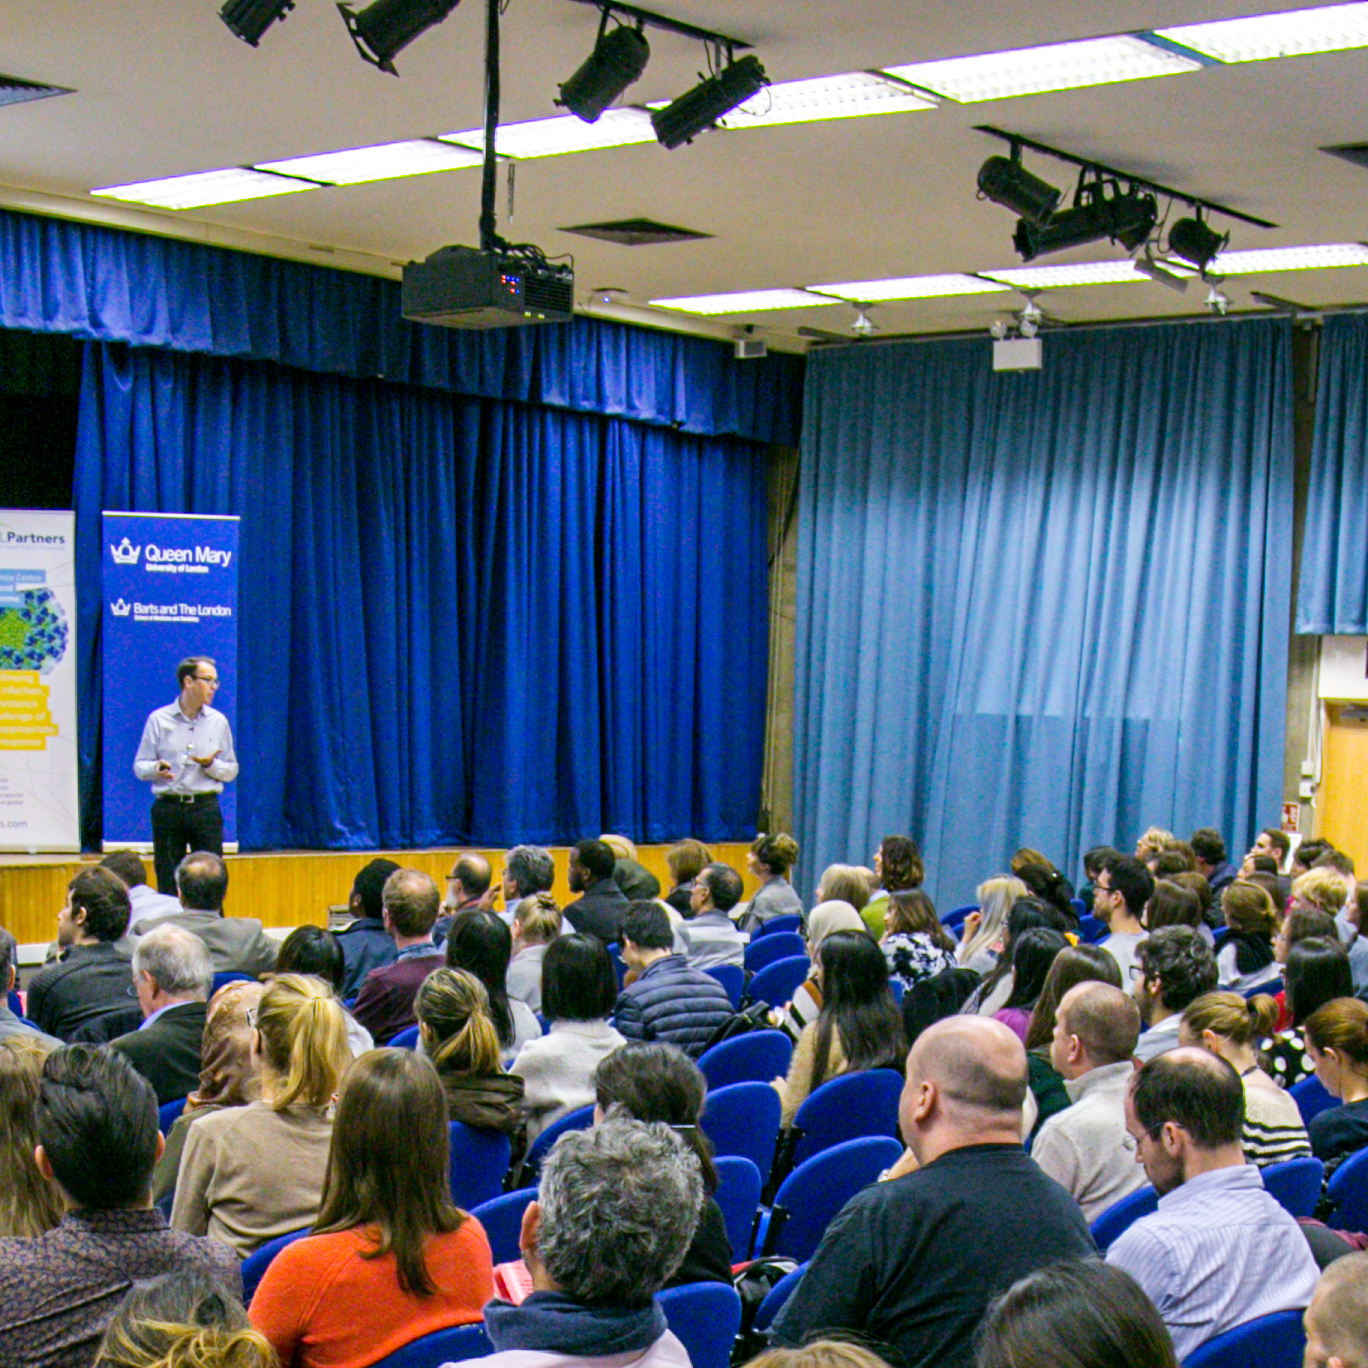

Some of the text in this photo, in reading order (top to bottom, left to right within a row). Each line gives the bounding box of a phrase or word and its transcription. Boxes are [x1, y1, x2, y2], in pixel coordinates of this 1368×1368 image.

[145, 544, 232, 568] Queen Mary
[145, 562, 209, 573] University of London
[15, 573, 43, 583] Centre
[134, 602, 232, 617] Barts and The London
[35, 711, 46, 721] of
